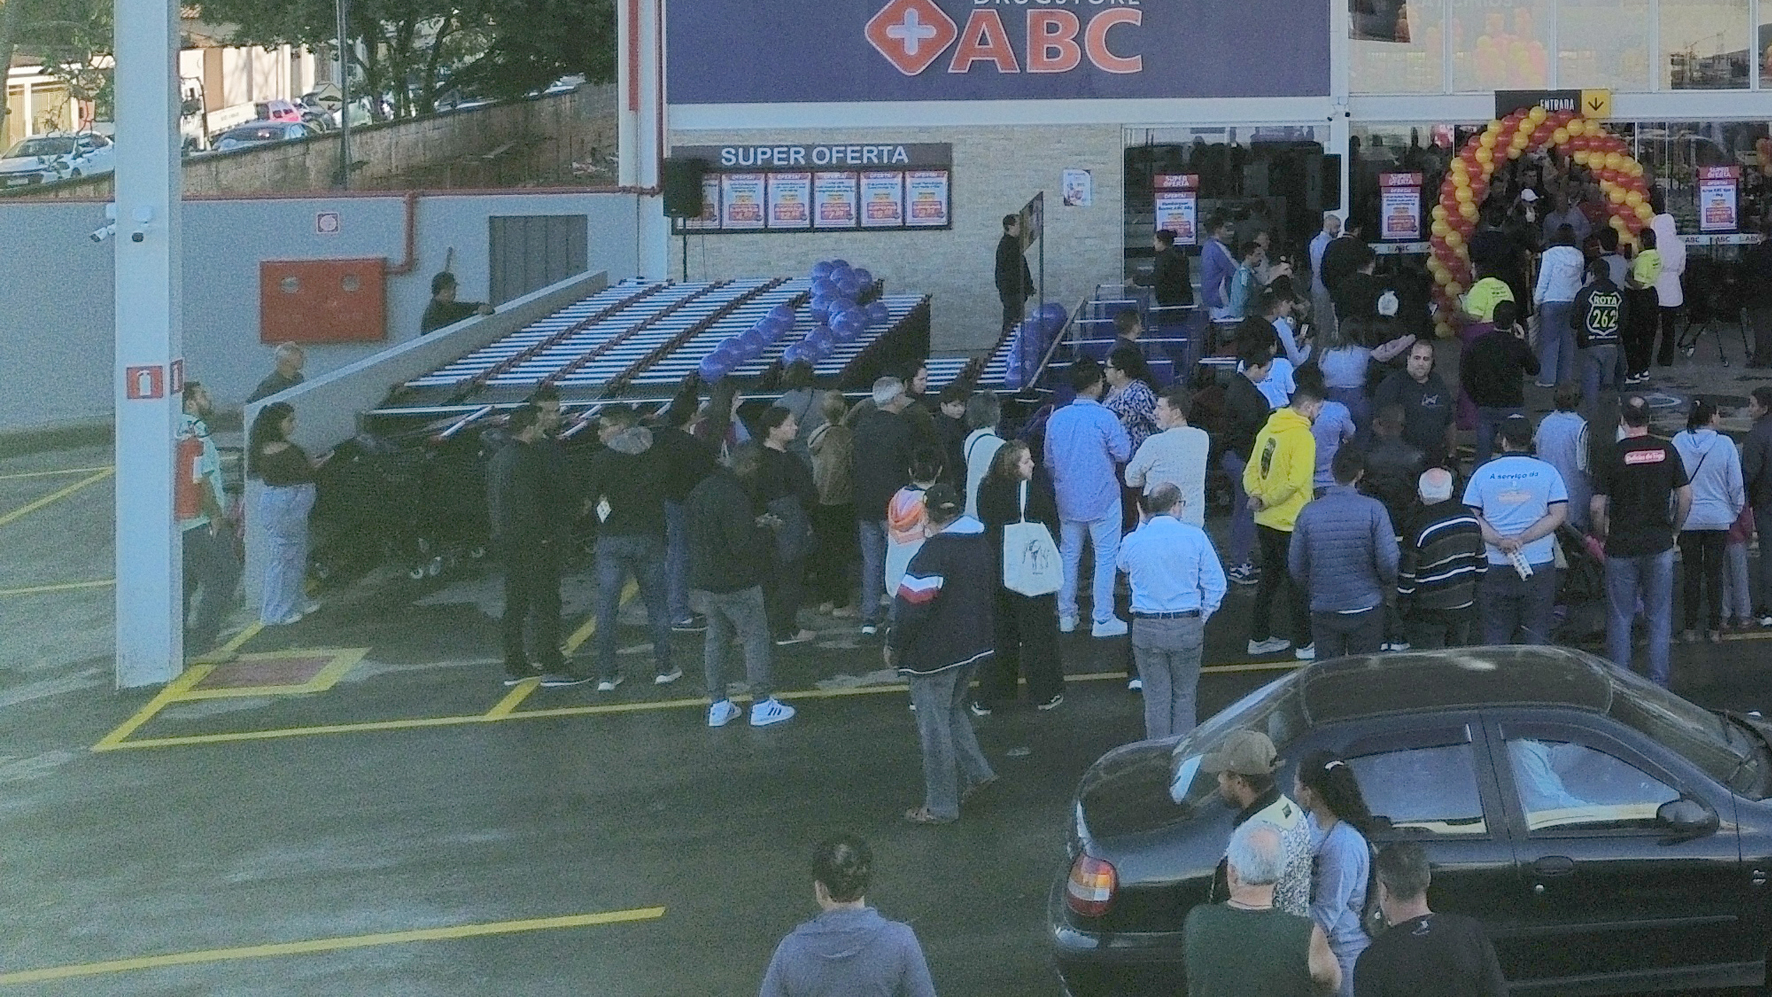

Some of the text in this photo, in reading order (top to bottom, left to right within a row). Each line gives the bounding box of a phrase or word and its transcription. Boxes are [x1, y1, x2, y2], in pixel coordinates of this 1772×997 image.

[947, 8, 1143, 73] ABC
[1540, 98, 1575, 111] ENTRADA
[721, 146, 909, 165] SUPER OFERTA
[1593, 296, 1617, 305] ROTA
[1592, 309, 1617, 328] 262
